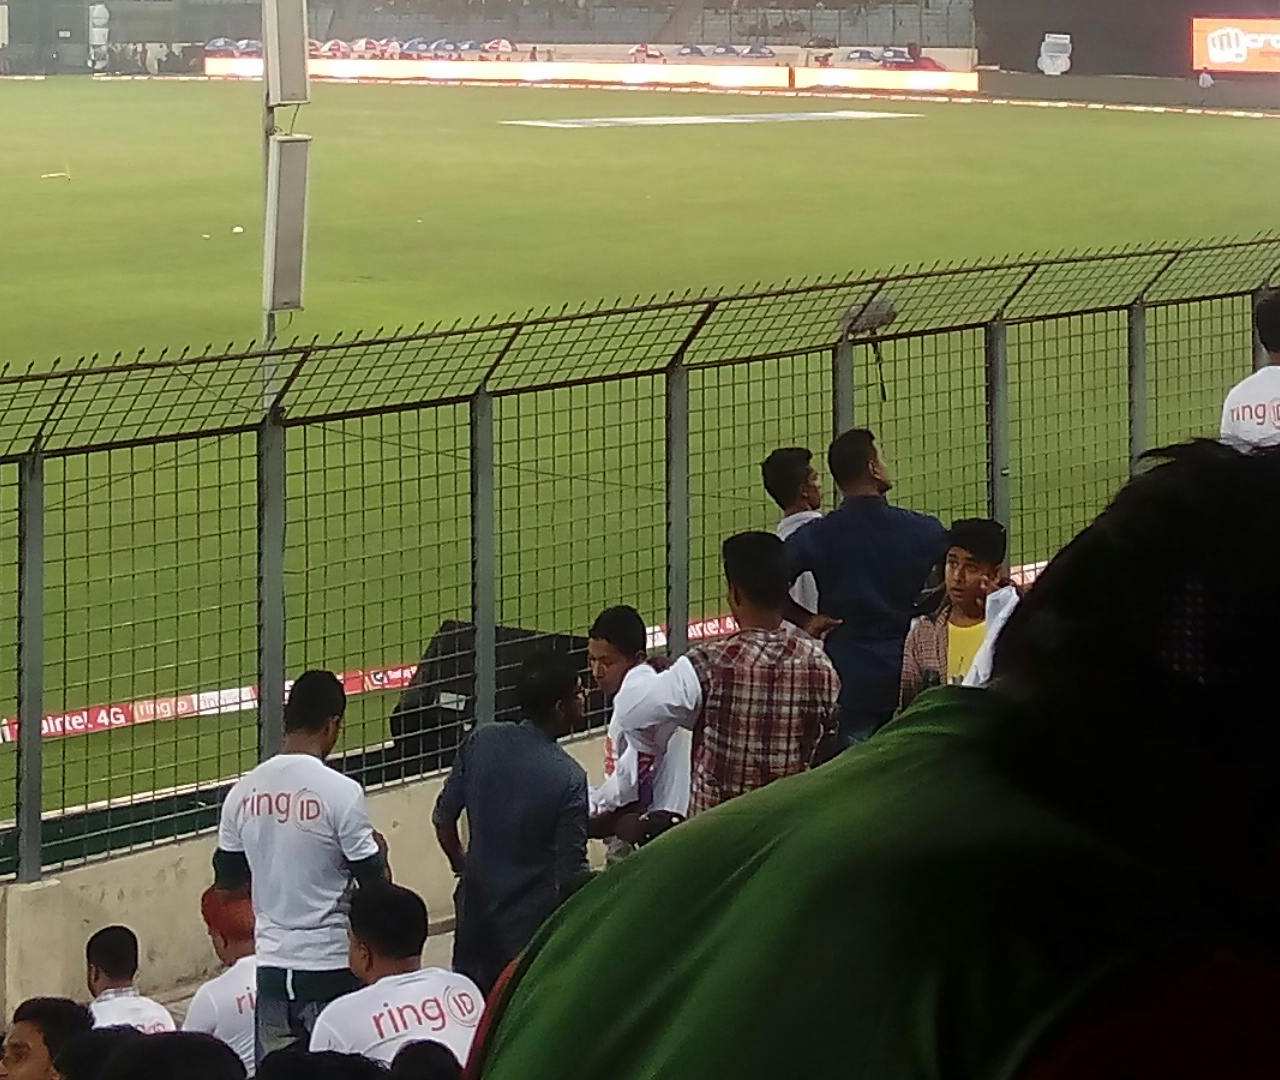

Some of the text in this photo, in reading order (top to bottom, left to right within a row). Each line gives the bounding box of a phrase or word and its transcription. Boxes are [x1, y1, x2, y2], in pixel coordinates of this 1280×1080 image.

[1231, 400, 1265, 425] ring
[97, 708, 126, 725] 4G
[241, 788, 320, 823] ring ID
[236, 986, 256, 1015] ri
[373, 992, 474, 1039] ring ID
